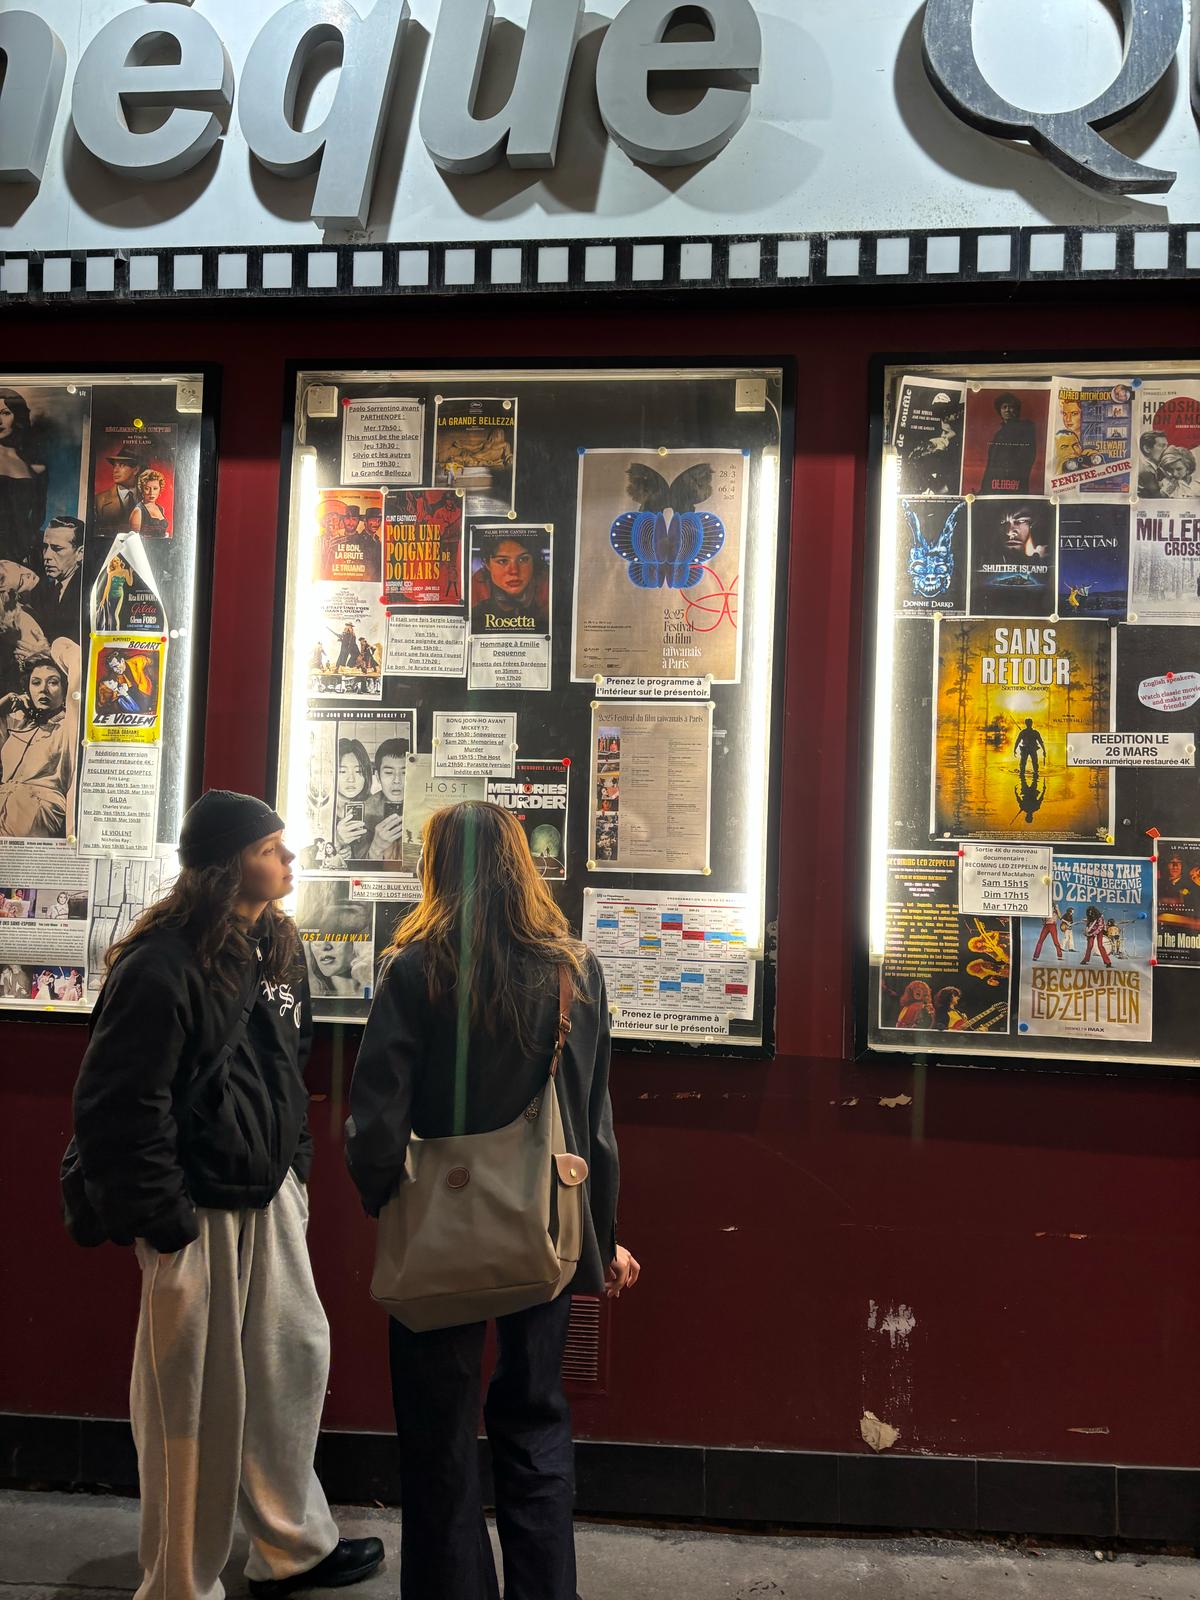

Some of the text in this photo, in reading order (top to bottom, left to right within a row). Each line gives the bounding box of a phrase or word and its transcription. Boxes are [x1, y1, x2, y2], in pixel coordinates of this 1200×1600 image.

[1059, 390, 1112, 401] ALFRED HITCHCOCK
[367, 405, 400, 413] Sorrentino
[900, 388, 912, 428] souffle
[438, 417, 447, 427] LA
[448, 416, 477, 426] GRANDE
[478, 416, 515, 427] BELLEZZA
[378, 424, 397, 432] 17h50
[402, 433, 419, 441] place
[1095, 440, 1127, 451] STEWART
[1108, 449, 1128, 459] KELLY
[385, 469, 412, 477] Bellezza
[1105, 461, 1132, 475] COUR
[385, 524, 441, 542] POUR UNE
[337, 543, 345, 552] LE
[1060, 537, 1119, 548] LA LA LAND
[1164, 541, 1200, 557] CROSS
[335, 551, 364, 560] LA BRUTE
[442, 551, 451, 562] DE
[332, 563, 366, 573] LE TRUAND
[385, 561, 440, 580] DOLLARS
[982, 563, 1048, 574] SHUTTER ISLAND
[931, 600, 954, 608] DARKO
[142, 615, 157, 624] FORD
[485, 613, 536, 628] Rosetta
[663, 620, 694, 632] Festival
[663, 632, 692, 644] du film
[994, 627, 1057, 656] SANS
[127, 641, 162, 650] BOGART
[480, 641, 513, 649] Hommage
[493, 650, 527, 658] Dequenne
[668, 658, 689, 669] Paris
[980, 656, 1071, 686] RETOUR
[606, 677, 702, 687] Prenez le programme à
[1142, 679, 1166, 688] English
[596, 687, 637, 696] l'intérieur
[653, 688, 662, 696] le
[663, 688, 710, 697] présentoir.
[1140, 692, 1161, 701] Watch
[1161, 689, 1182, 698] classic
[1152, 698, 1164, 706] and
[93, 712, 159, 728] LE VIOLENT
[1091, 734, 1169, 745] REEDITION LE
[1105, 746, 1159, 757] 26 MARS
[1072, 757, 1101, 765] Version
[1102, 757, 1142, 766] numérique
[1142, 757, 1179, 765] restaurée
[425, 782, 468, 793] HOST
[487, 783, 567, 795] MEMORIES
[109, 796, 128, 804] GILDA
[487, 794, 567, 810] MURDER
[109, 830, 132, 838] VIOLENT
[928, 858, 956, 867] ZEPPELIN
[1052, 861, 1142, 879] ALL ACCESS TRIP
[981, 878, 1029, 888] Sam 15h15
[1072, 873, 1100, 887] THEY
[1101, 877, 1142, 890] BECAME
[983, 890, 1029, 900] Dim 17h15
[1065, 882, 1142, 904] ZEPPELIN
[982, 902, 1028, 912] Mar 17h20
[302, 933, 370, 943] OST HIGHWAY
[1164, 931, 1176, 948] the
[1031, 966, 1141, 993] BECOMING
[621, 1009, 720, 1024] Prenez le programme à
[611, 1020, 728, 1034] l'intérieur sur le présentoir.
